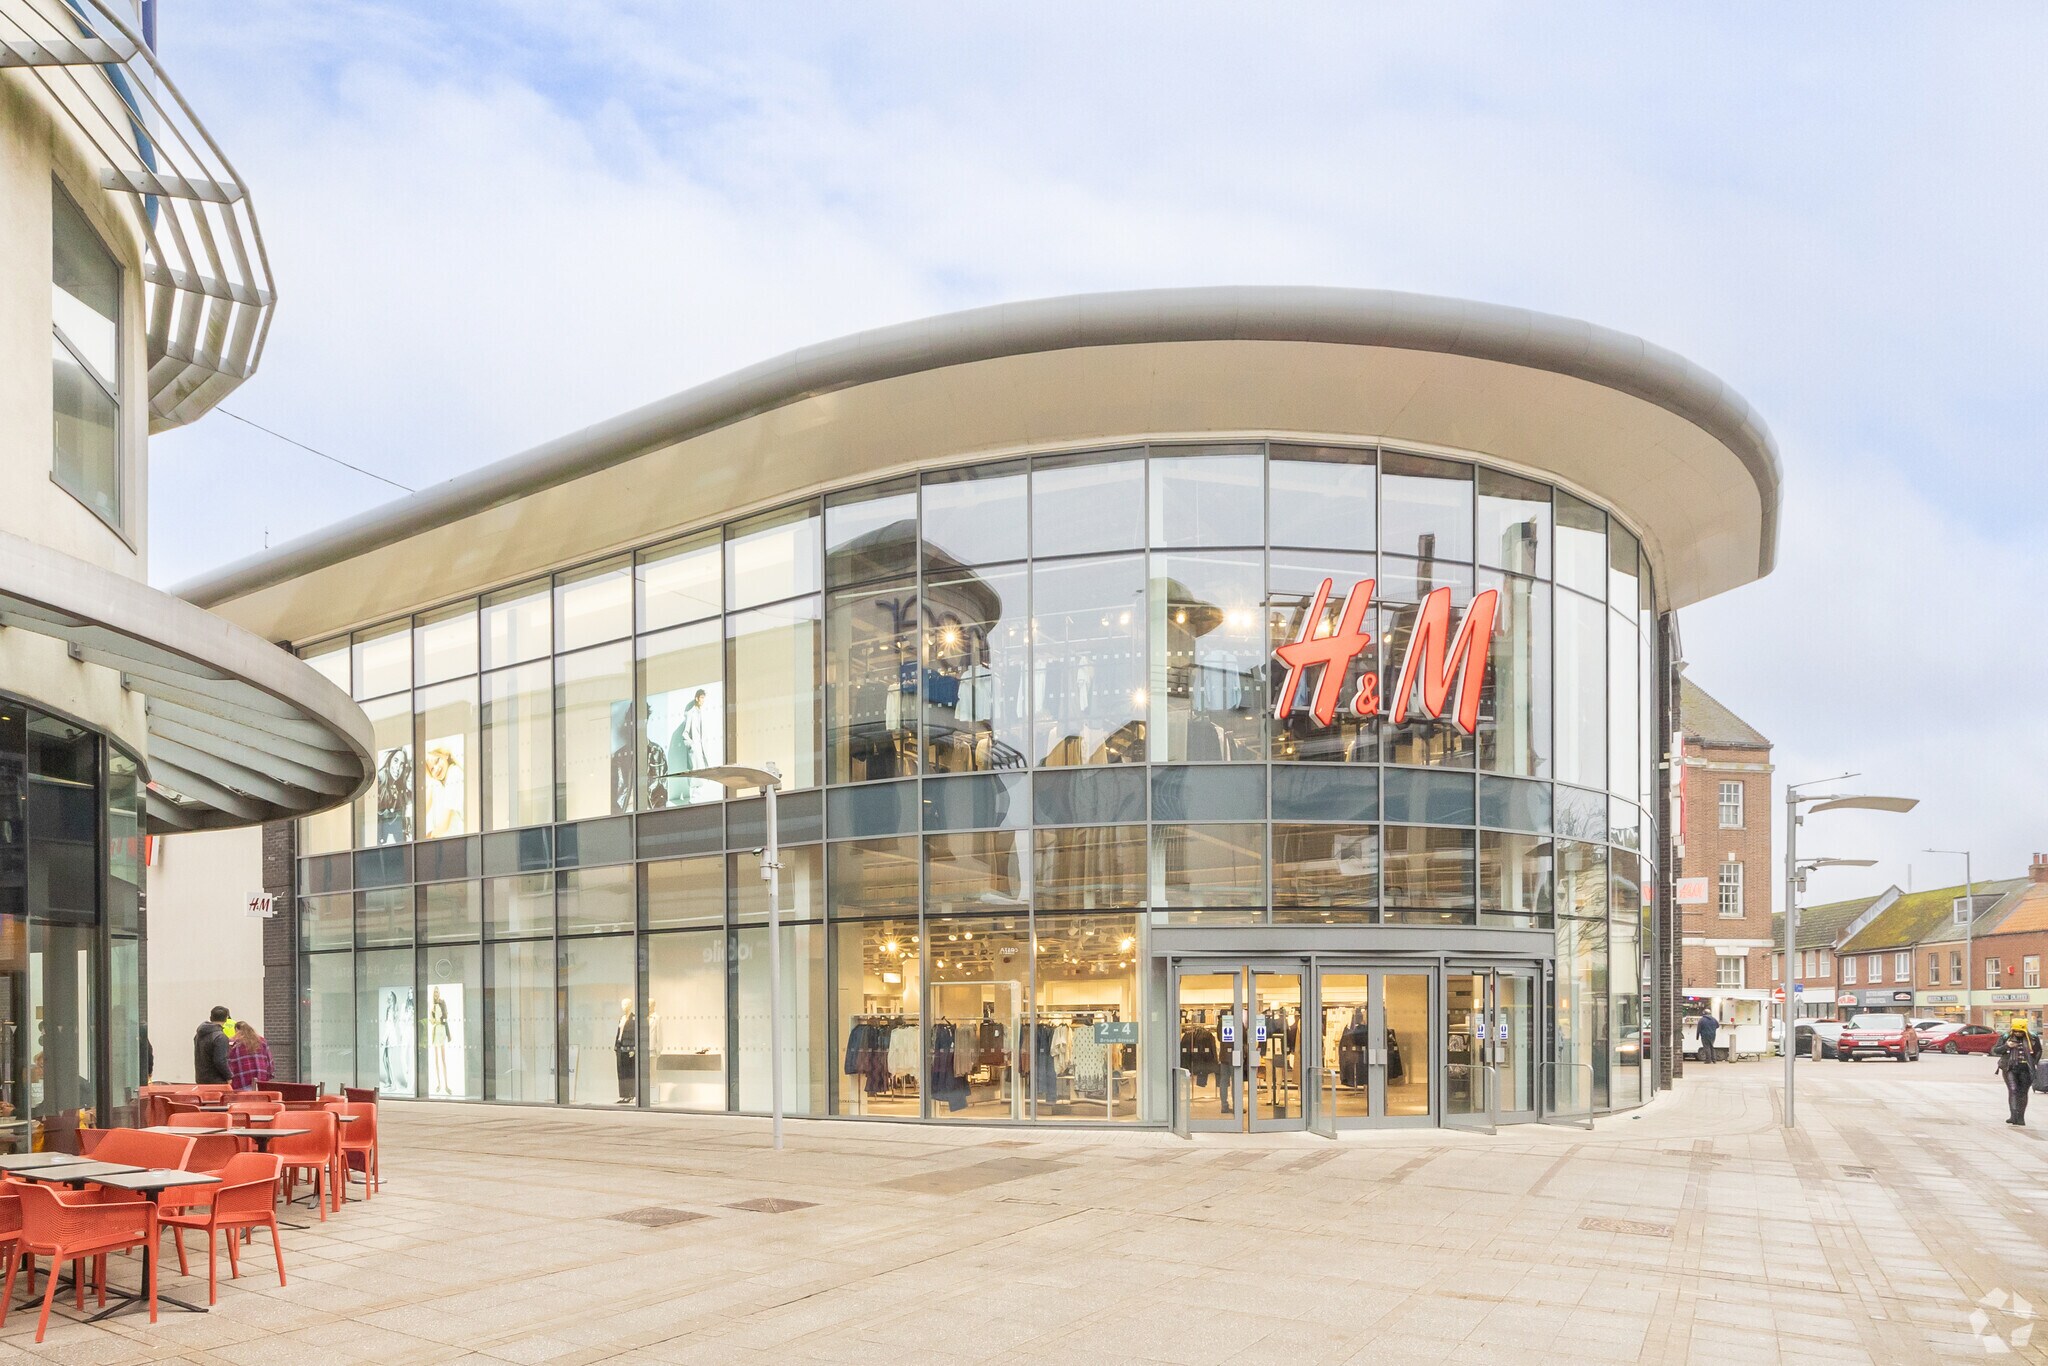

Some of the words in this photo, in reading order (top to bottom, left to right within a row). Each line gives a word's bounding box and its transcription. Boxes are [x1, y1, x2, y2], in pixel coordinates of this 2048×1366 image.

[1271, 577, 1498, 735] H&M
[249, 897, 270, 912] H&M
[1100, 1022, 1110, 1035] 2
[1121, 1022, 1131, 1035] 4
